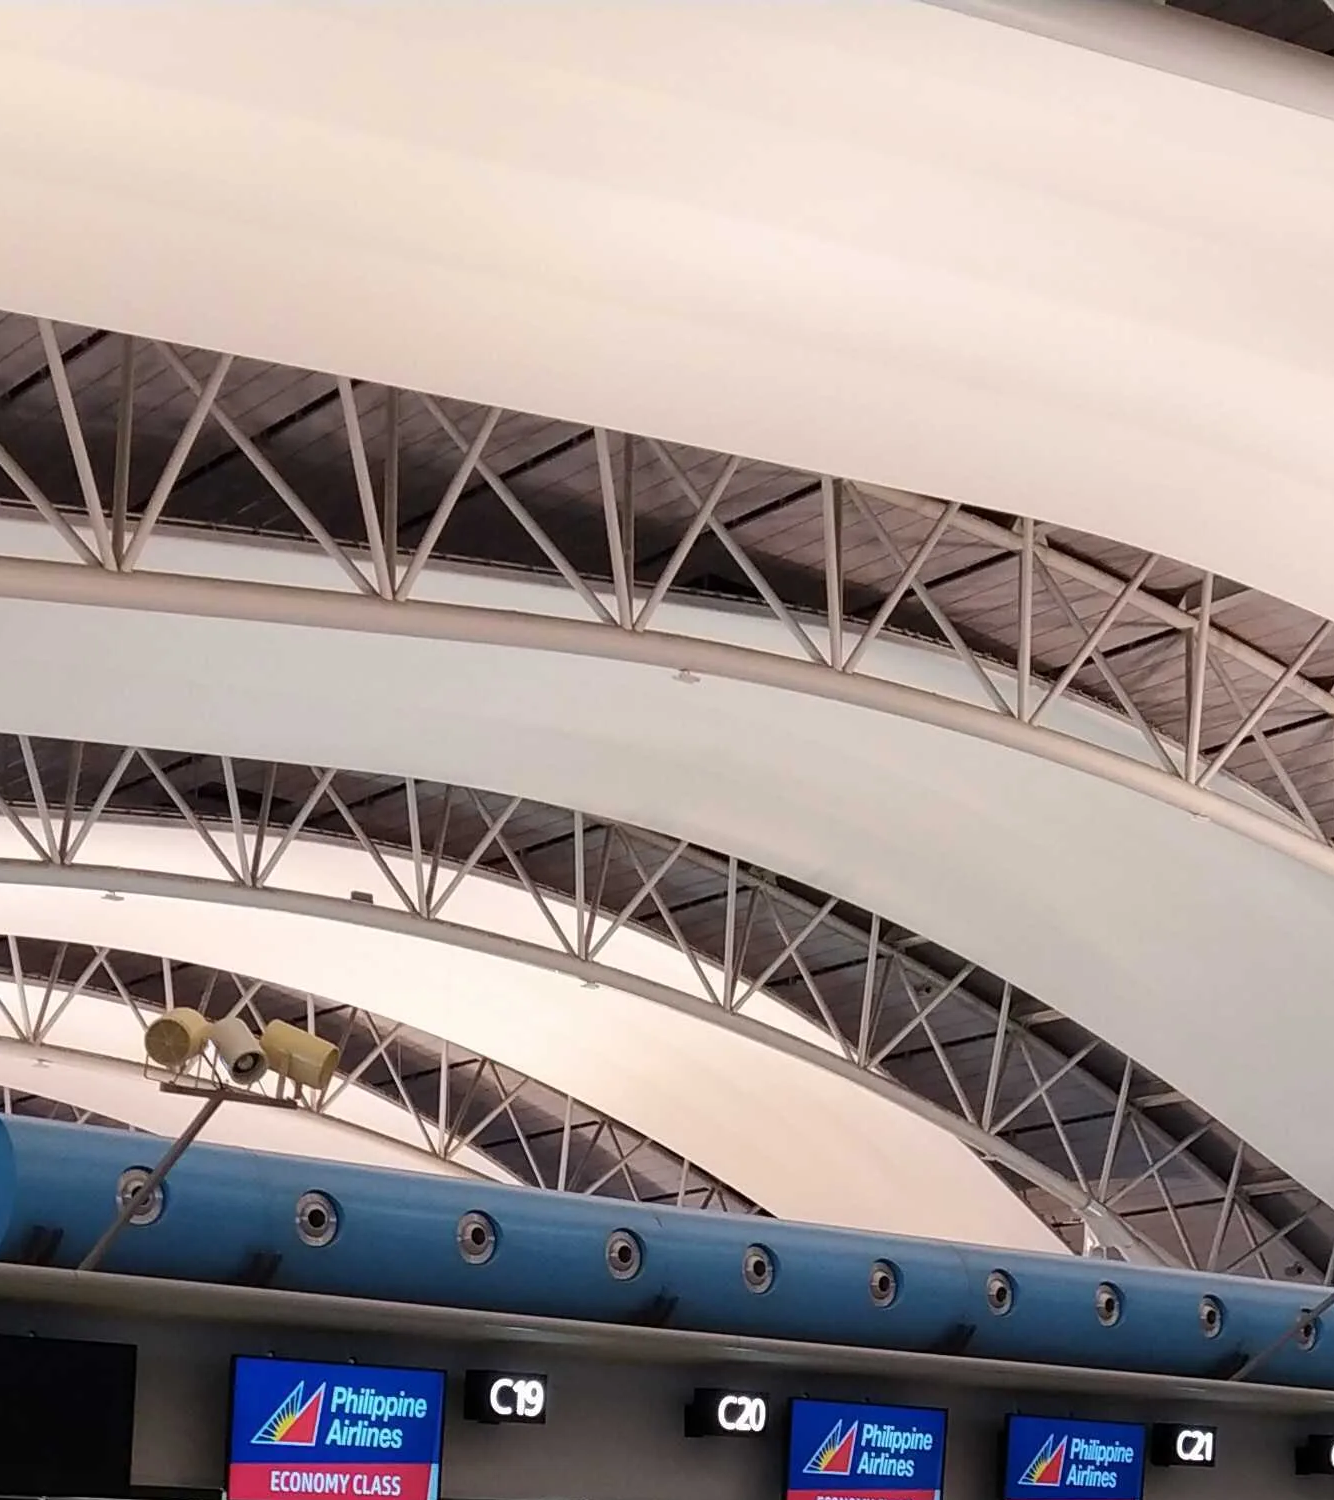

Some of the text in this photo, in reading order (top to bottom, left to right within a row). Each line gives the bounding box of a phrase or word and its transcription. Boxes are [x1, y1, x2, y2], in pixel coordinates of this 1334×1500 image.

[330, 1386, 427, 1422] Philippine
[489, 1378, 545, 1418] C19
[717, 1395, 766, 1433] C20
[325, 1419, 404, 1449] Airlines
[861, 1423, 933, 1454] Philippine
[1176, 1429, 1214, 1461] C21
[856, 1451, 915, 1477] Airlines
[1070, 1438, 1134, 1467] Philippine
[270, 1470, 402, 1497] ECONOMY CLASS
[1066, 1464, 1117, 1488] Airlines
